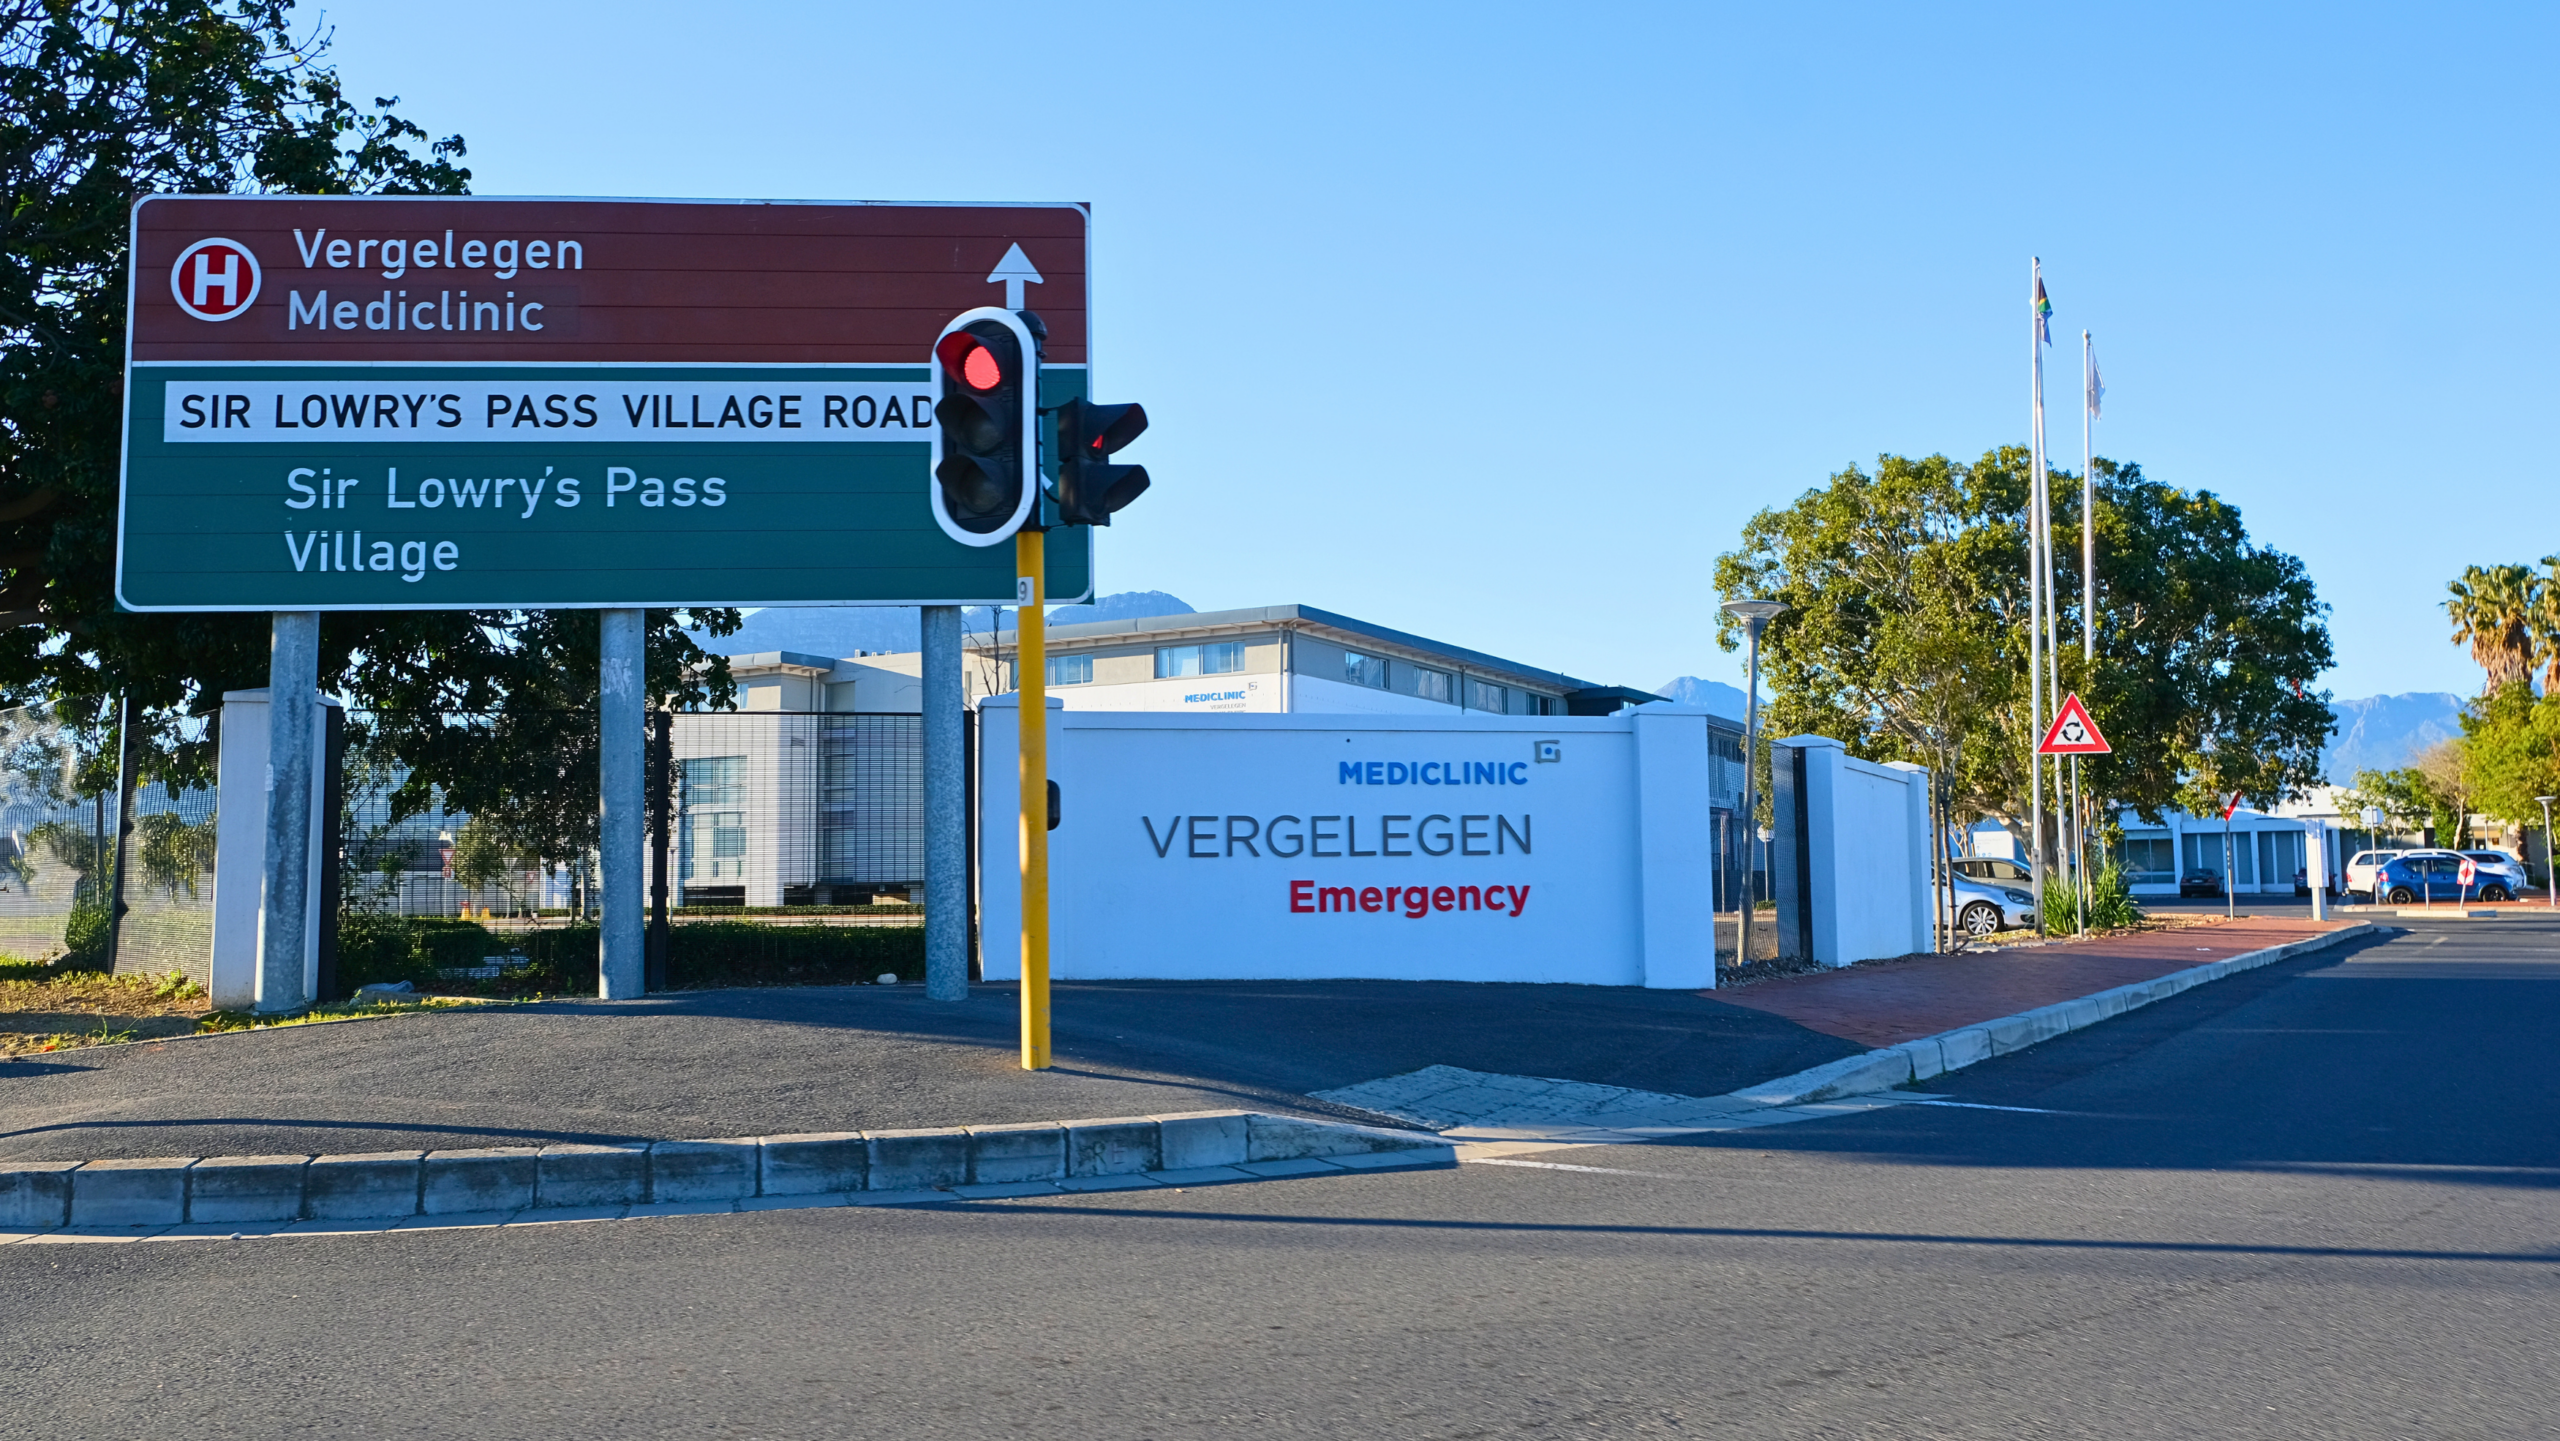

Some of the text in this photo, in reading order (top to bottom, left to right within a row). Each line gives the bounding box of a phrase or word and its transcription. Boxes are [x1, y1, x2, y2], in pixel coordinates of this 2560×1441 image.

[293, 229, 583, 279] Vergelegen
[193, 254, 239, 306] H
[288, 290, 545, 331] Mediclinic
[179, 394, 932, 428] SIR LOWRY'S PASS VILLAGE ROAD
[284, 466, 727, 519] Sir Lowry's Pass
[284, 530, 459, 582] Village
[1184, 690, 1246, 703] MEDICLINIC
[1339, 761, 1529, 786] MEDICLINIC
[1142, 814, 1532, 858] VERGELEGEN
[1290, 880, 1531, 919] Emergency
